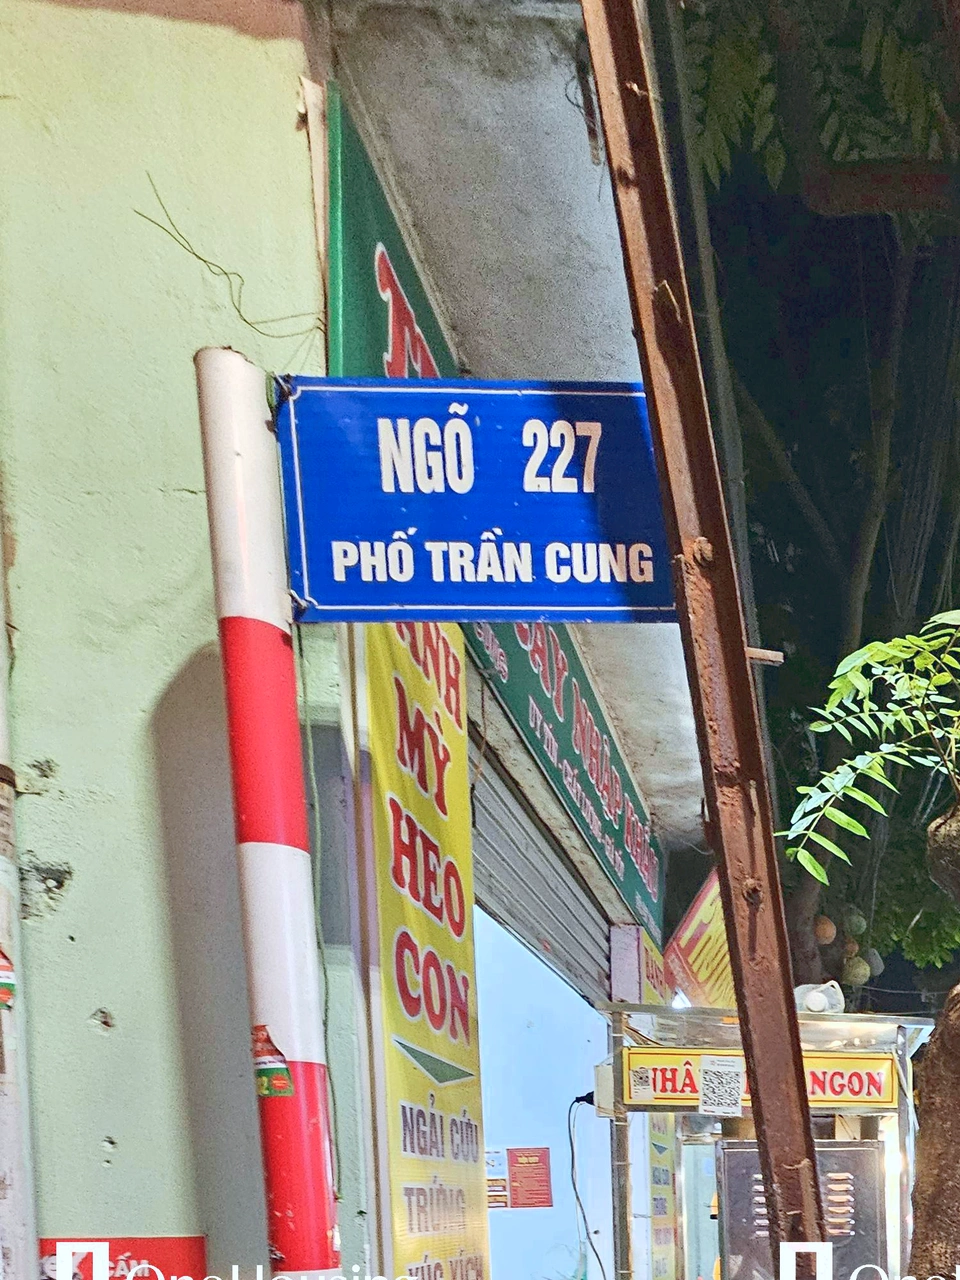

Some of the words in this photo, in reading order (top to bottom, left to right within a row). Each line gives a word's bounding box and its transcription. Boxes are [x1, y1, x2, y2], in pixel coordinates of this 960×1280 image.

[377, 402, 475, 494] NGÕ
[522, 419, 602, 494] 227
[331, 526, 416, 582] PHỐ
[424, 526, 533, 583] TRẦN
[544, 542, 654, 583] CUNG
[388, 796, 466, 938] HEO
[395, 930, 471, 1046] CON
[808, 1071, 884, 1097] NGON
[401, 1093, 445, 1158] NGẢI
